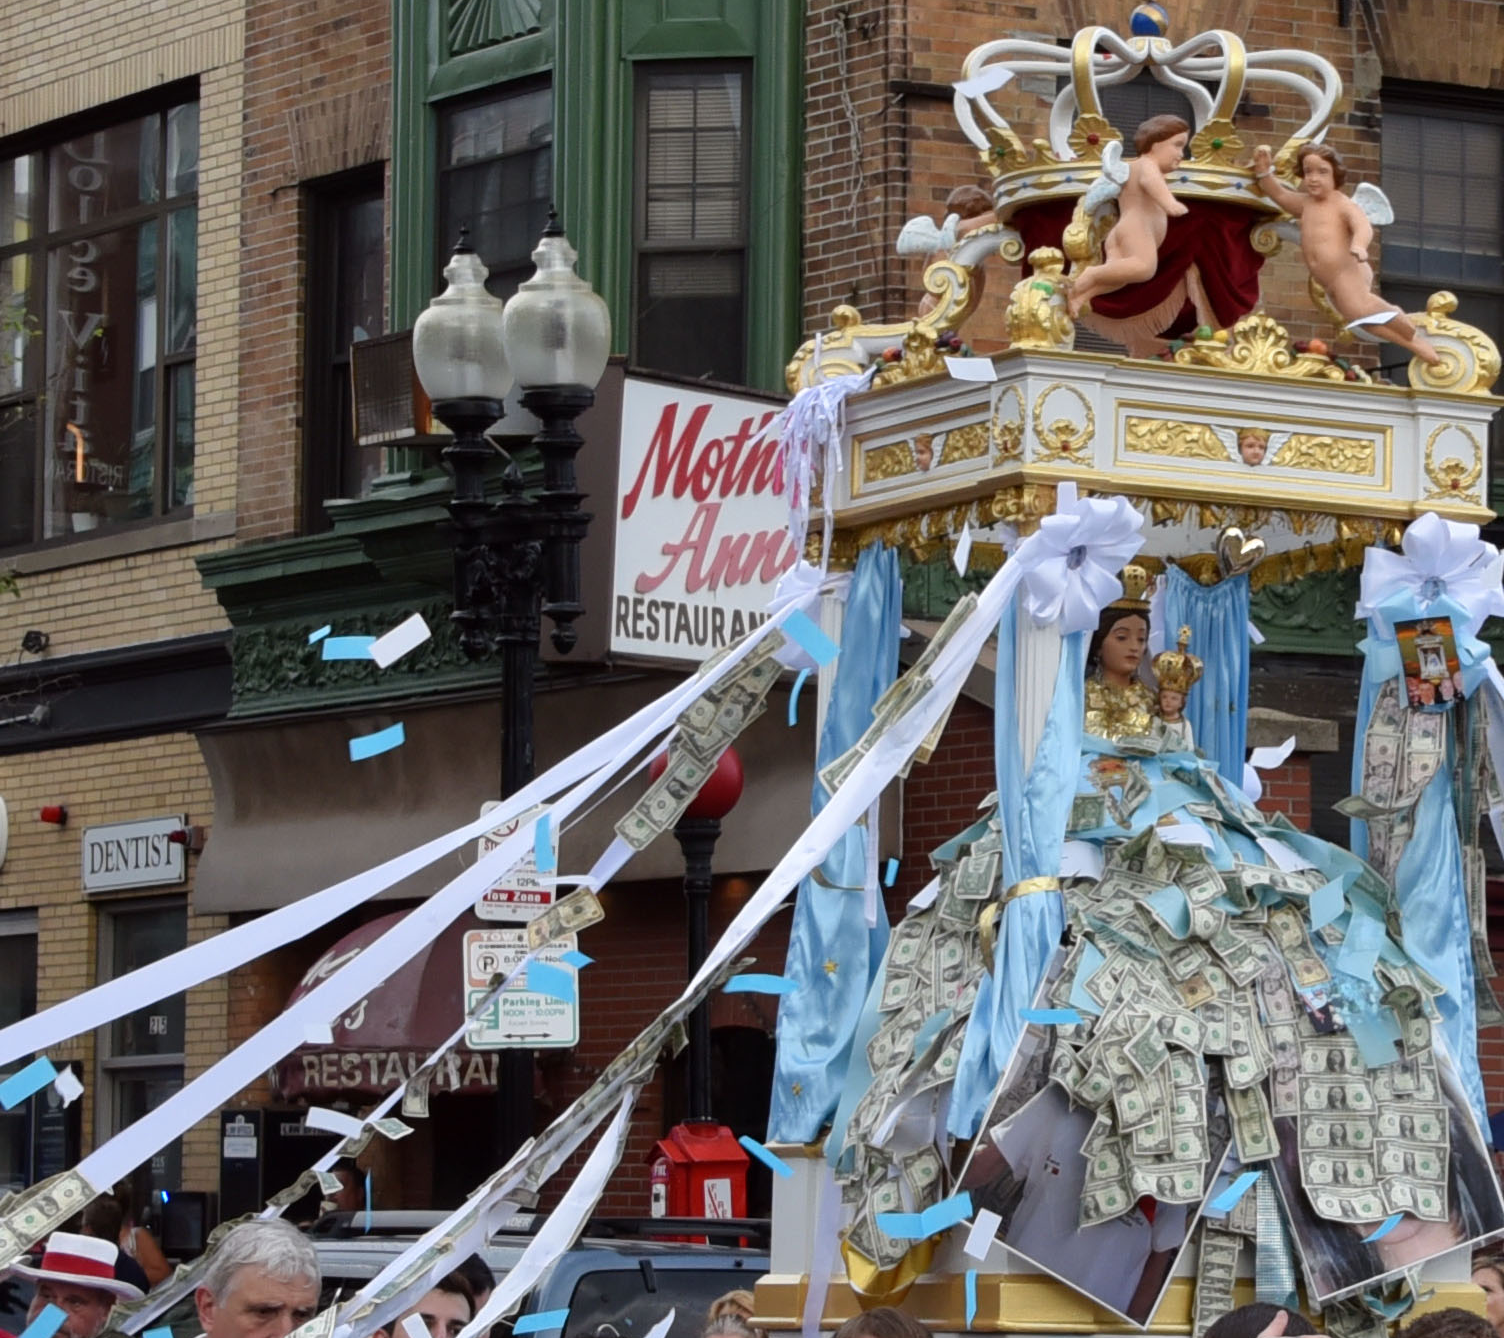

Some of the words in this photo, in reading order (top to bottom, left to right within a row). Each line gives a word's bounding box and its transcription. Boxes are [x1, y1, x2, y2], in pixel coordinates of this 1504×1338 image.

[621, 402, 796, 519] Moth
[615, 594, 777, 648] RESTAURAN
[88, 833, 176, 876] DENTIST
[513, 891, 541, 904] Zone
[502, 997, 541, 1008] Parking
[149, 1016, 168, 1035] 215
